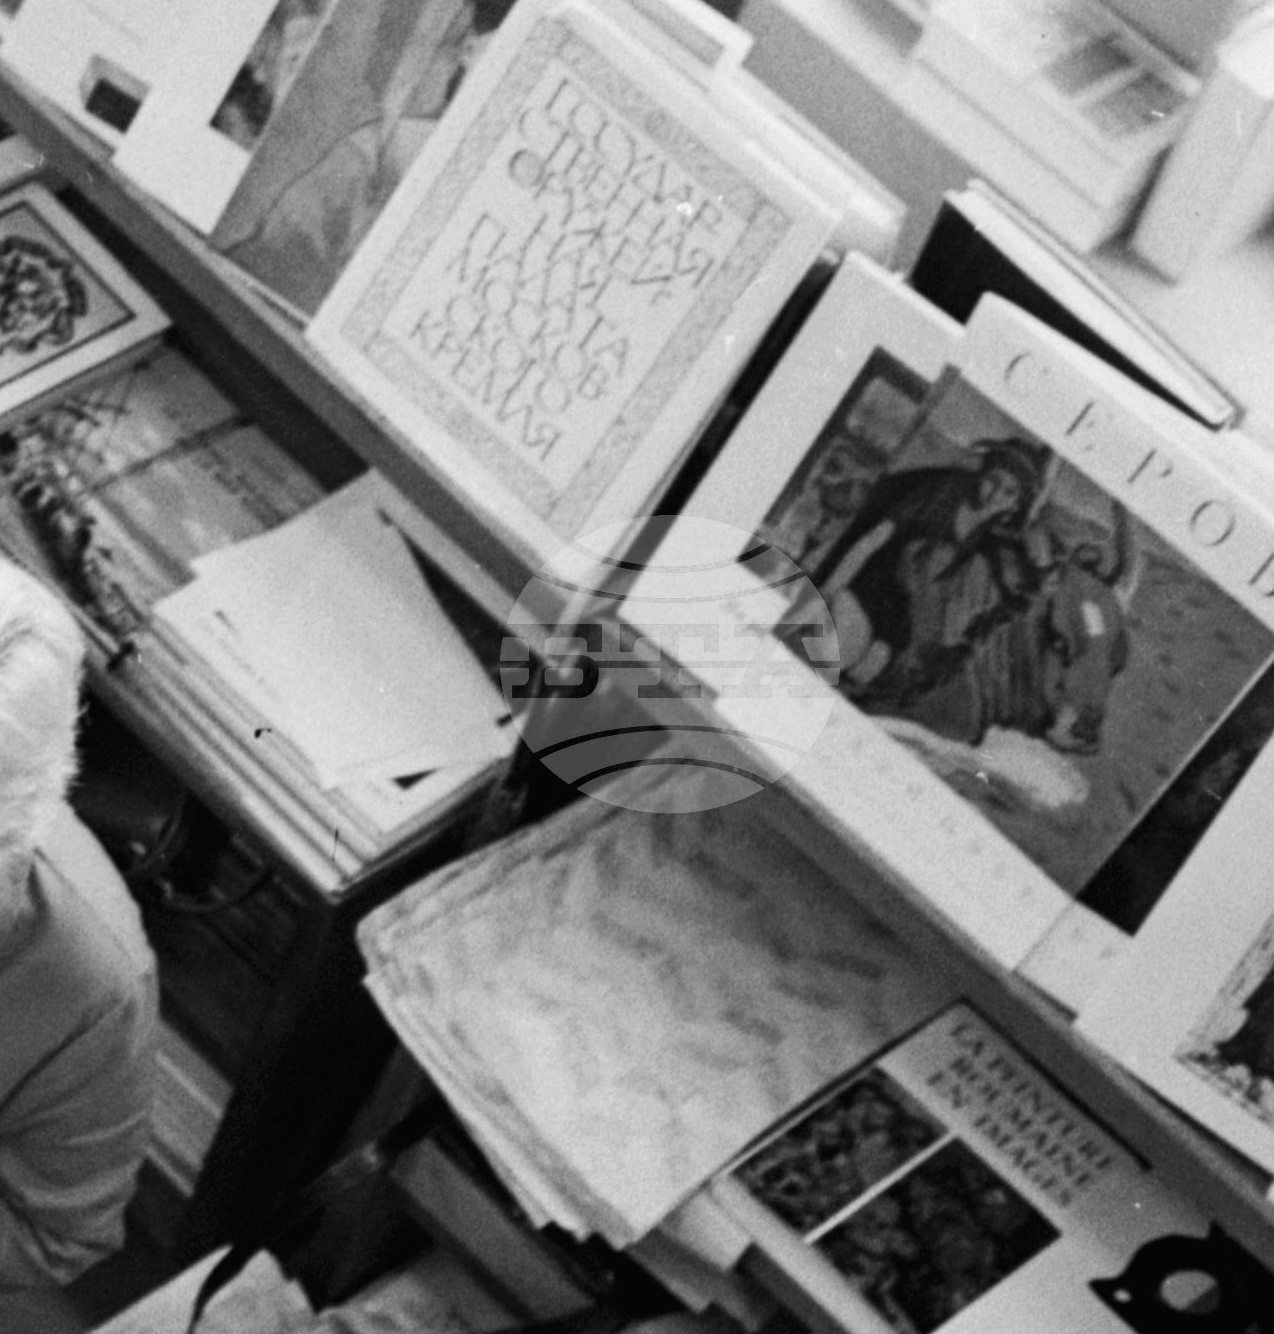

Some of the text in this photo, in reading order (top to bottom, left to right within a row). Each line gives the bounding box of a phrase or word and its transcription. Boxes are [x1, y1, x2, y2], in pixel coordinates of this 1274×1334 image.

[518, 108, 715, 289] СТВЕННАЯ
[445, 246, 609, 400] МОСКОВ
[446, 296, 572, 415] СКОГО
[461, 213, 629, 376] ПАЛАТА
[409, 310, 561, 461] КРЕМЛЯ
